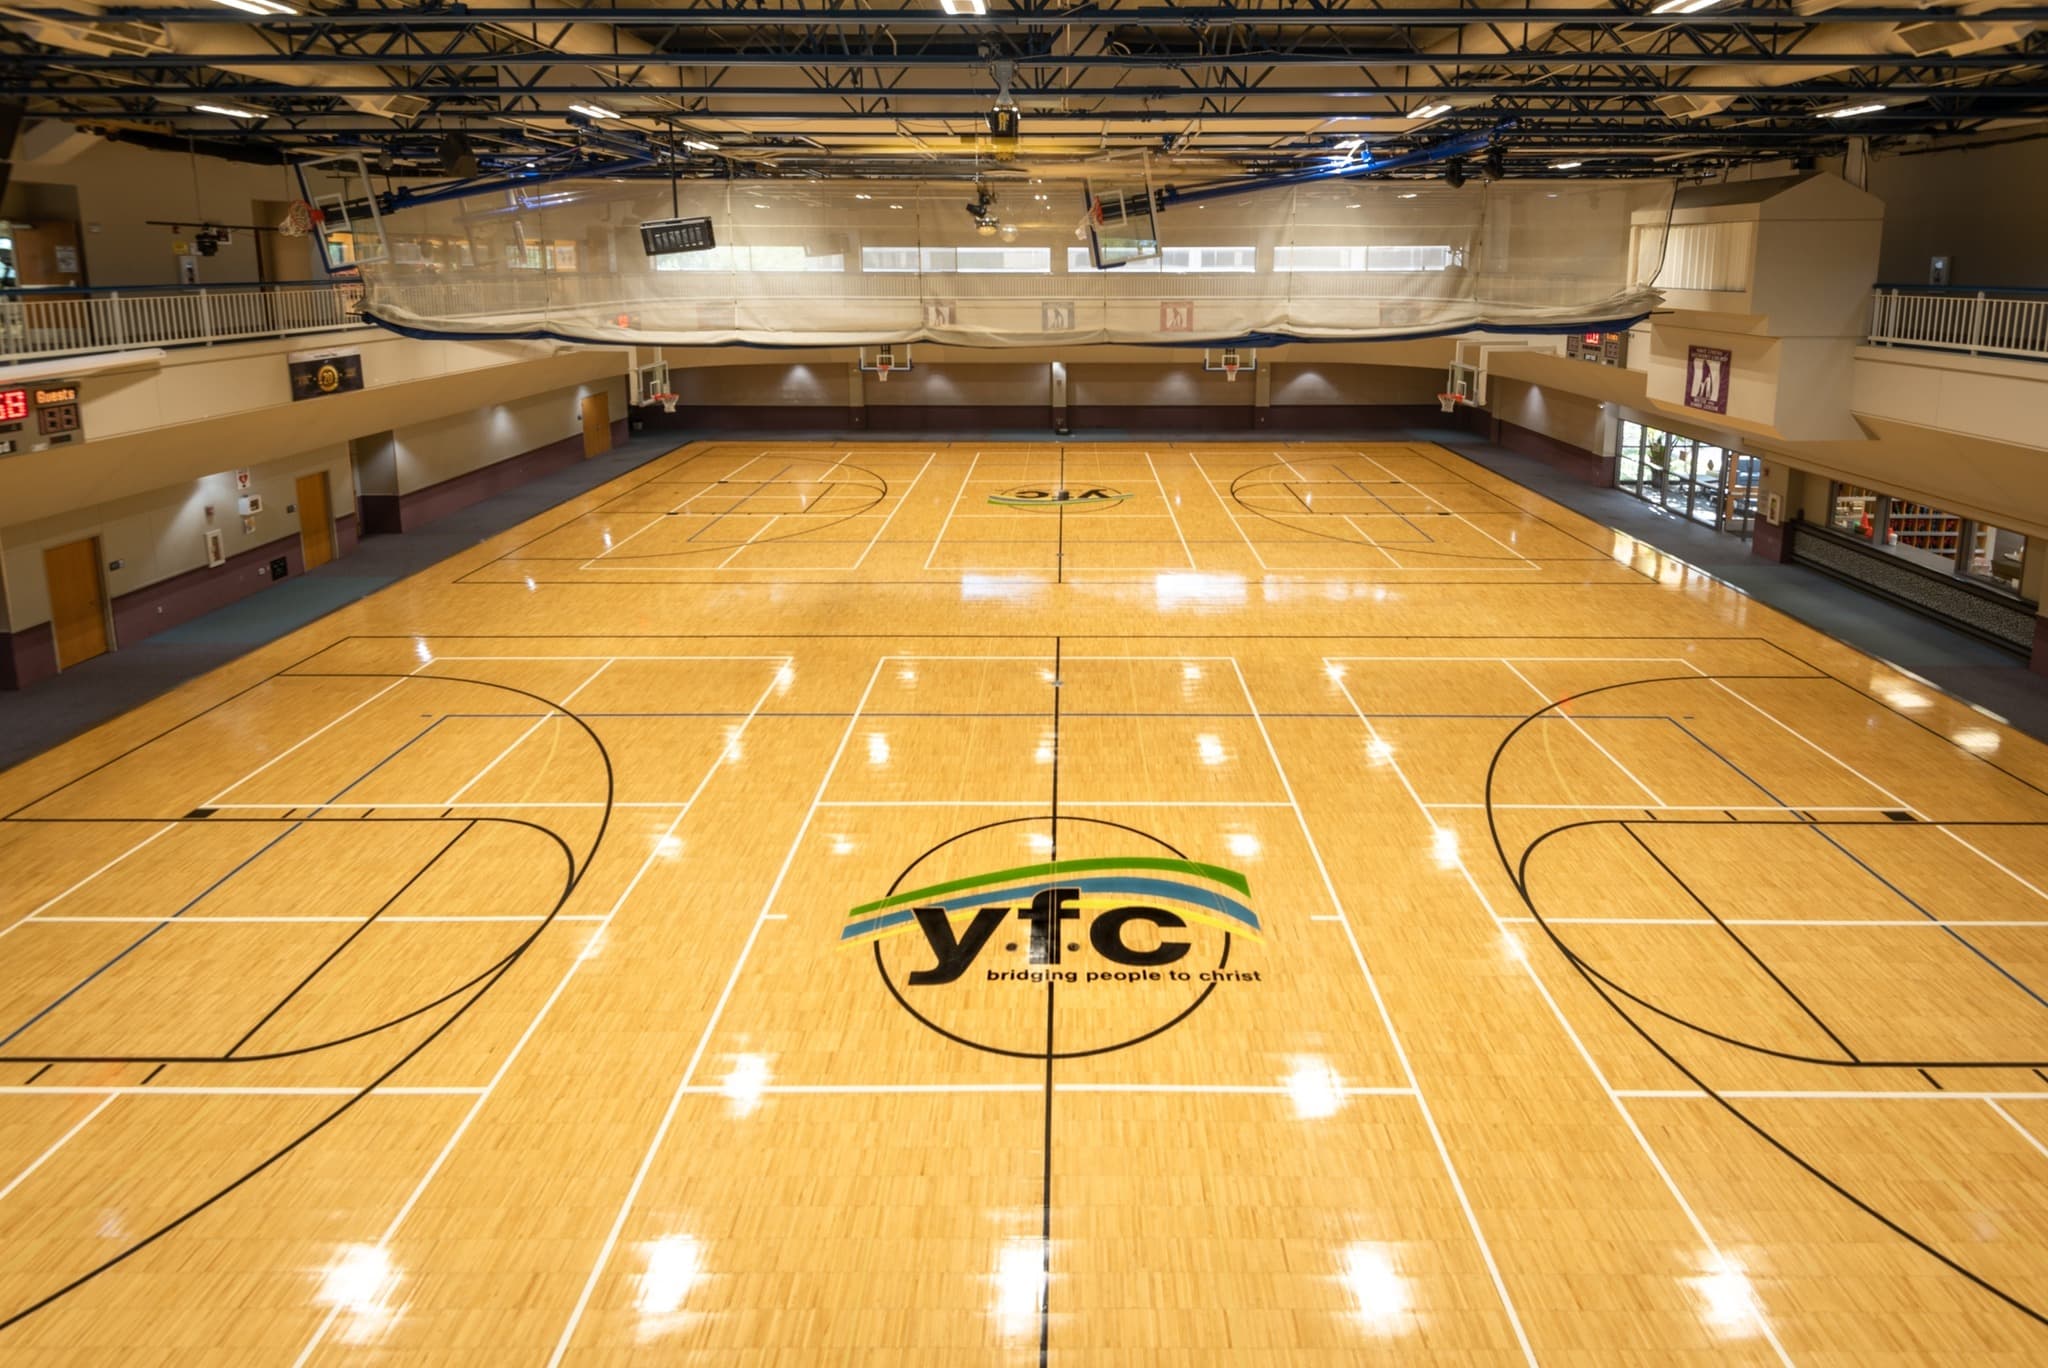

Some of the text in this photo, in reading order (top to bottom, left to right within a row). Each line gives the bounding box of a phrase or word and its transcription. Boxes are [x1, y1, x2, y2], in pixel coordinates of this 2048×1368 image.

[36, 388, 76, 404] Guests
[986, 969, 1262, 983] bridging people to christ
